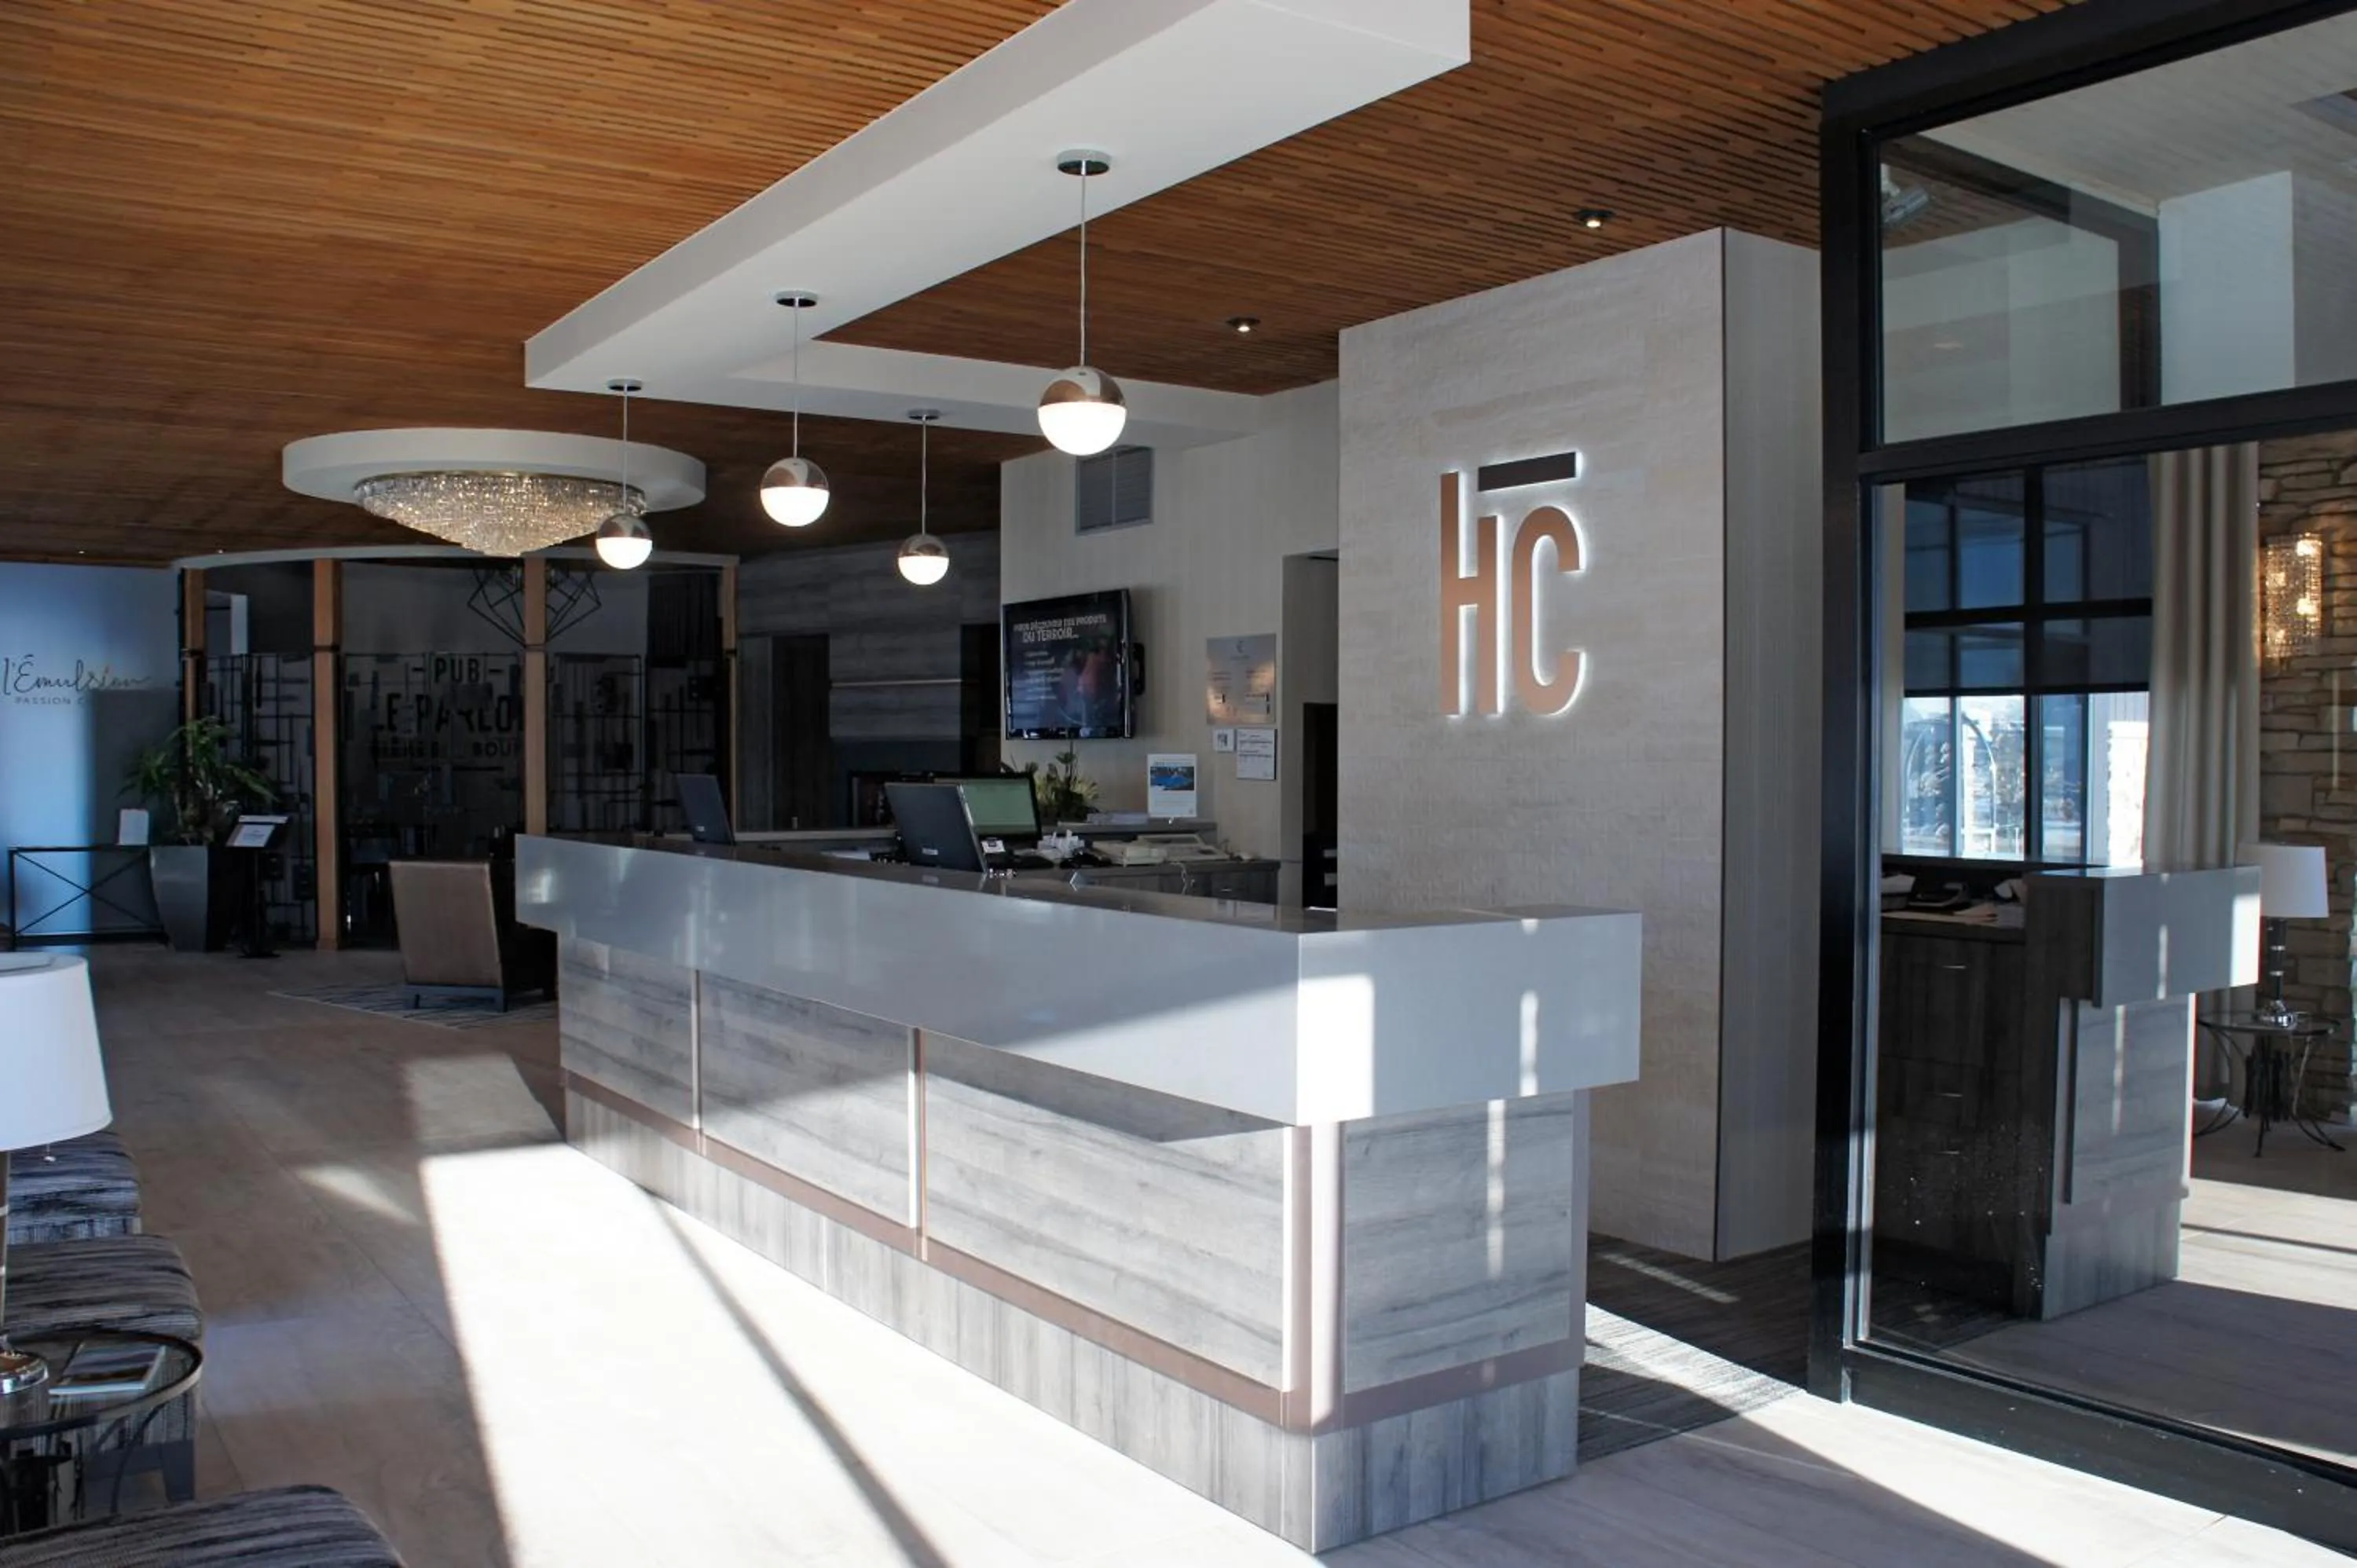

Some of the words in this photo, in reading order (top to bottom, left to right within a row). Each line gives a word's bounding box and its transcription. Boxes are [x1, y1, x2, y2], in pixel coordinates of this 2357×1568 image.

[1439, 470, 1582, 716] HC
[1022, 631, 1035, 643] DU
[434, 658, 479, 683] PUB
